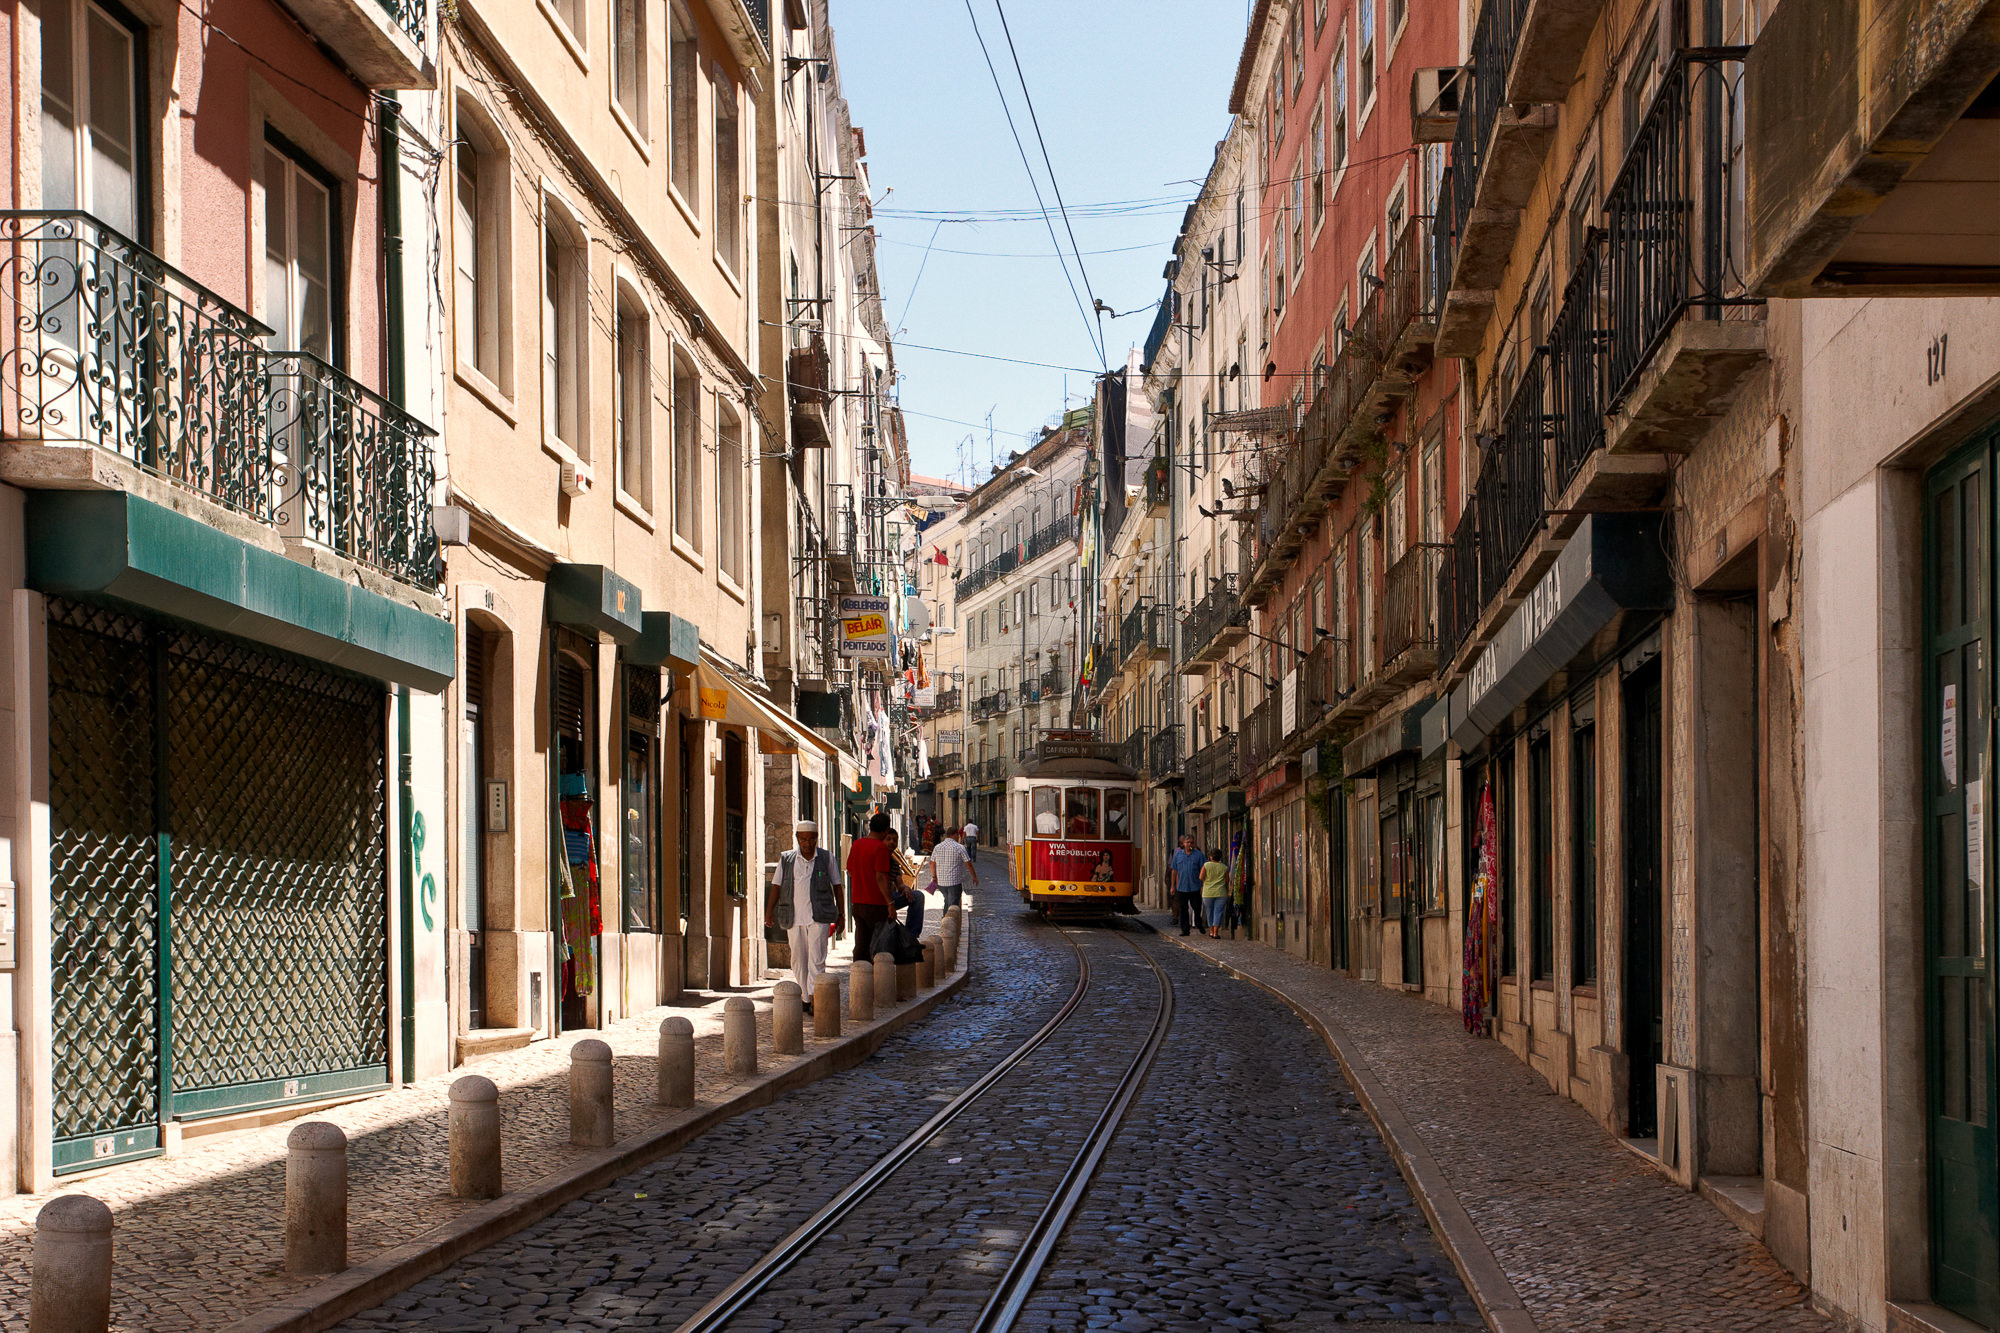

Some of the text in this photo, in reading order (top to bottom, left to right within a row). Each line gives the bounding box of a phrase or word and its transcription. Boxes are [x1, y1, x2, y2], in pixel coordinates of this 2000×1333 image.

[1927, 333, 1948, 386] 127
[485, 589, 494, 611] 104
[841, 598, 889, 612] CABELEIREIRO
[1521, 561, 1561, 652] INELBA
[847, 617, 882, 634] BELAIR
[843, 641, 887, 651] PENTEADOS
[1468, 642, 1497, 711] INELBA
[700, 697, 726, 710] Nicola
[1099, 746, 1111, 755] 12
[1056, 848, 1100, 857] REPÚBLICA!
